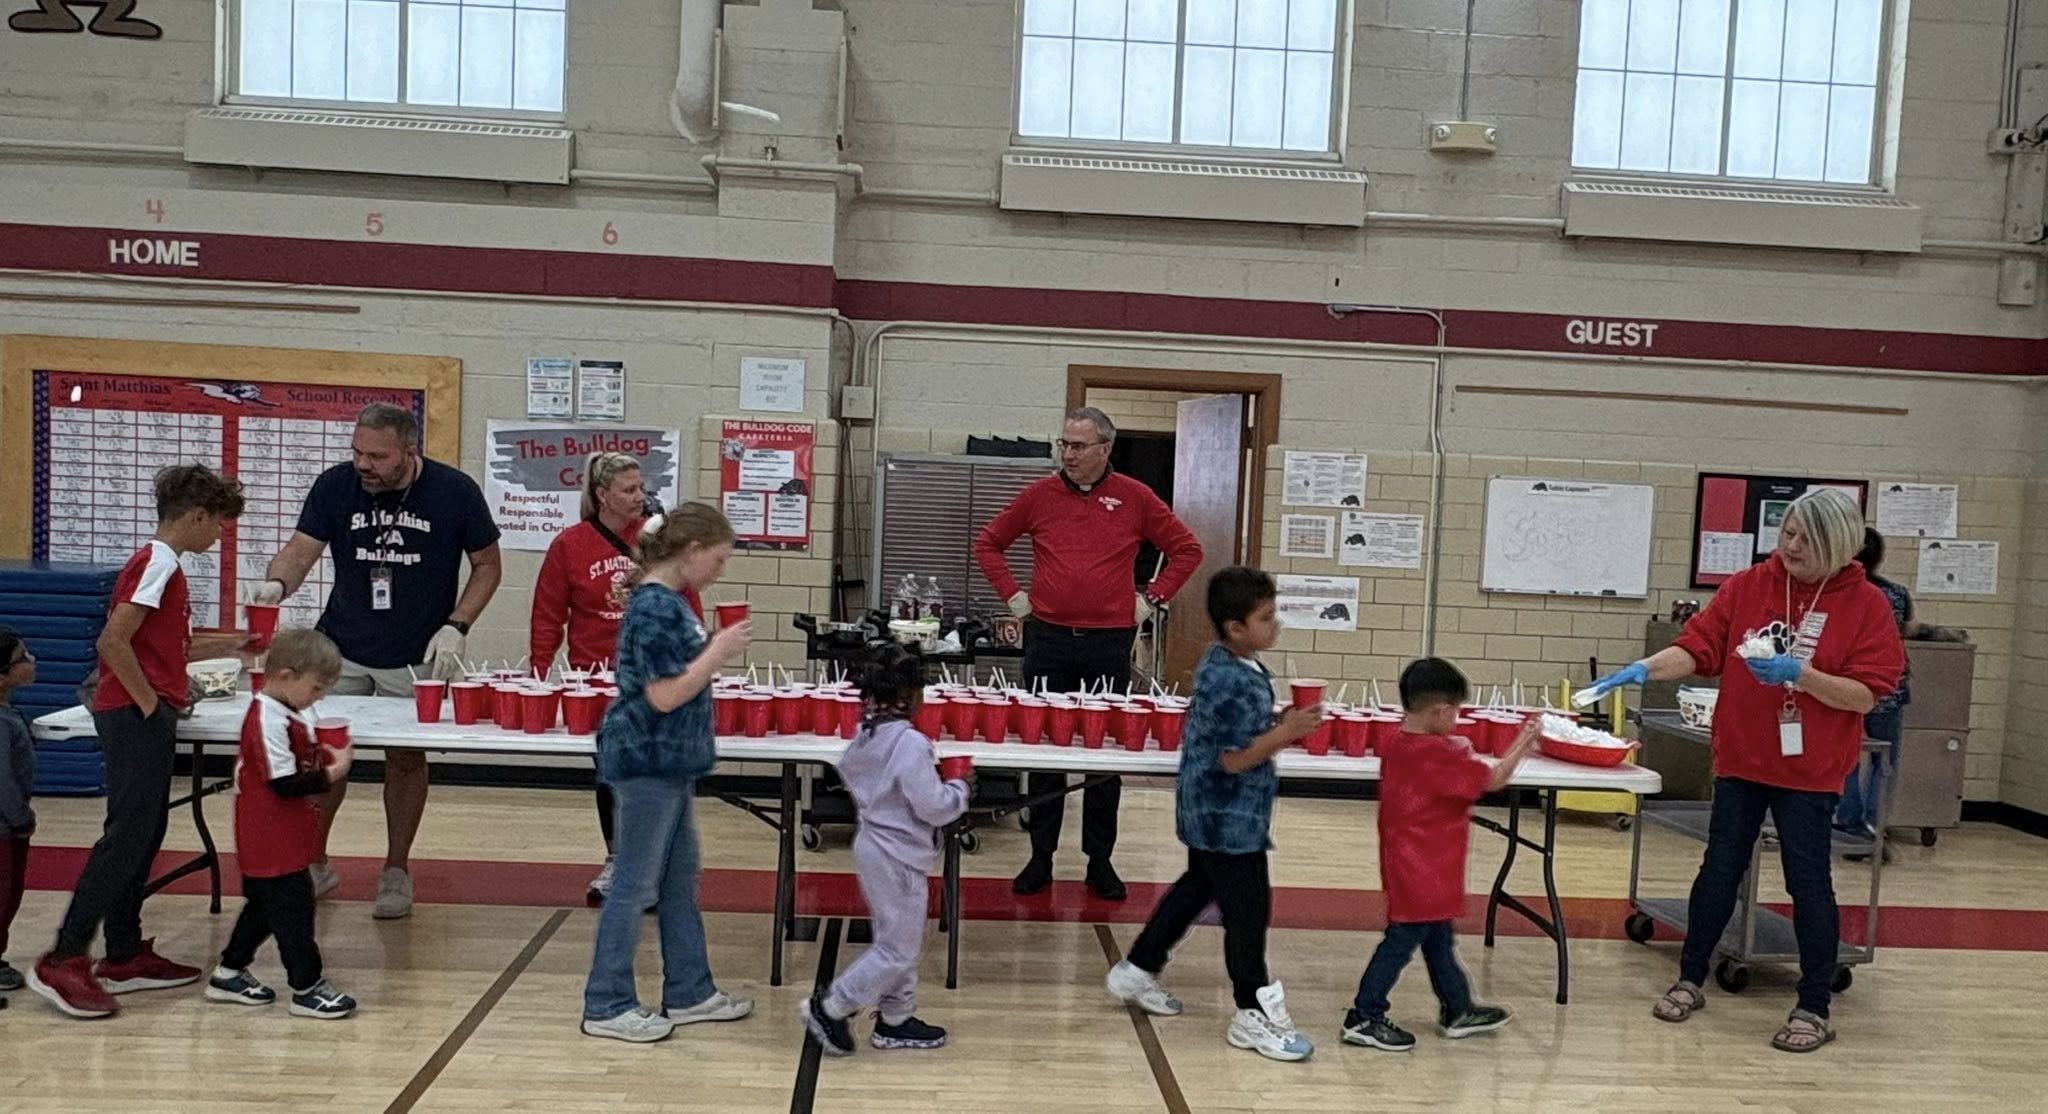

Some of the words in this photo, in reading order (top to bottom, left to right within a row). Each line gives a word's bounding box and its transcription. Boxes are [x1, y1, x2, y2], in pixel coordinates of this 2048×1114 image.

[144, 198, 165, 224] 4
[366, 211, 384, 237] 5
[603, 222, 618, 246] 6
[109, 238, 201, 267] HOME
[1565, 319, 1659, 348] GUEST
[287, 388, 338, 404] School
[723, 421, 741, 431] THE
[742, 422, 786, 433] BULLDOG
[786, 424, 813, 434] CODE
[738, 432, 794, 442] CAFETERIA
[516, 438, 557, 459] The
[563, 433, 649, 456] Bulldog
[559, 467, 585, 487] Co
[504, 491, 560, 505] Respectful
[371, 510, 431, 533] Mathias
[499, 505, 564, 519] Responsible
[495, 520, 526, 531] ooted
[528, 521, 540, 532] in
[541, 522, 565, 533] Chri
[355, 547, 421, 566] Bulldogs
[589, 560, 604, 580] ST.
[603, 555, 637, 573] MATTH
